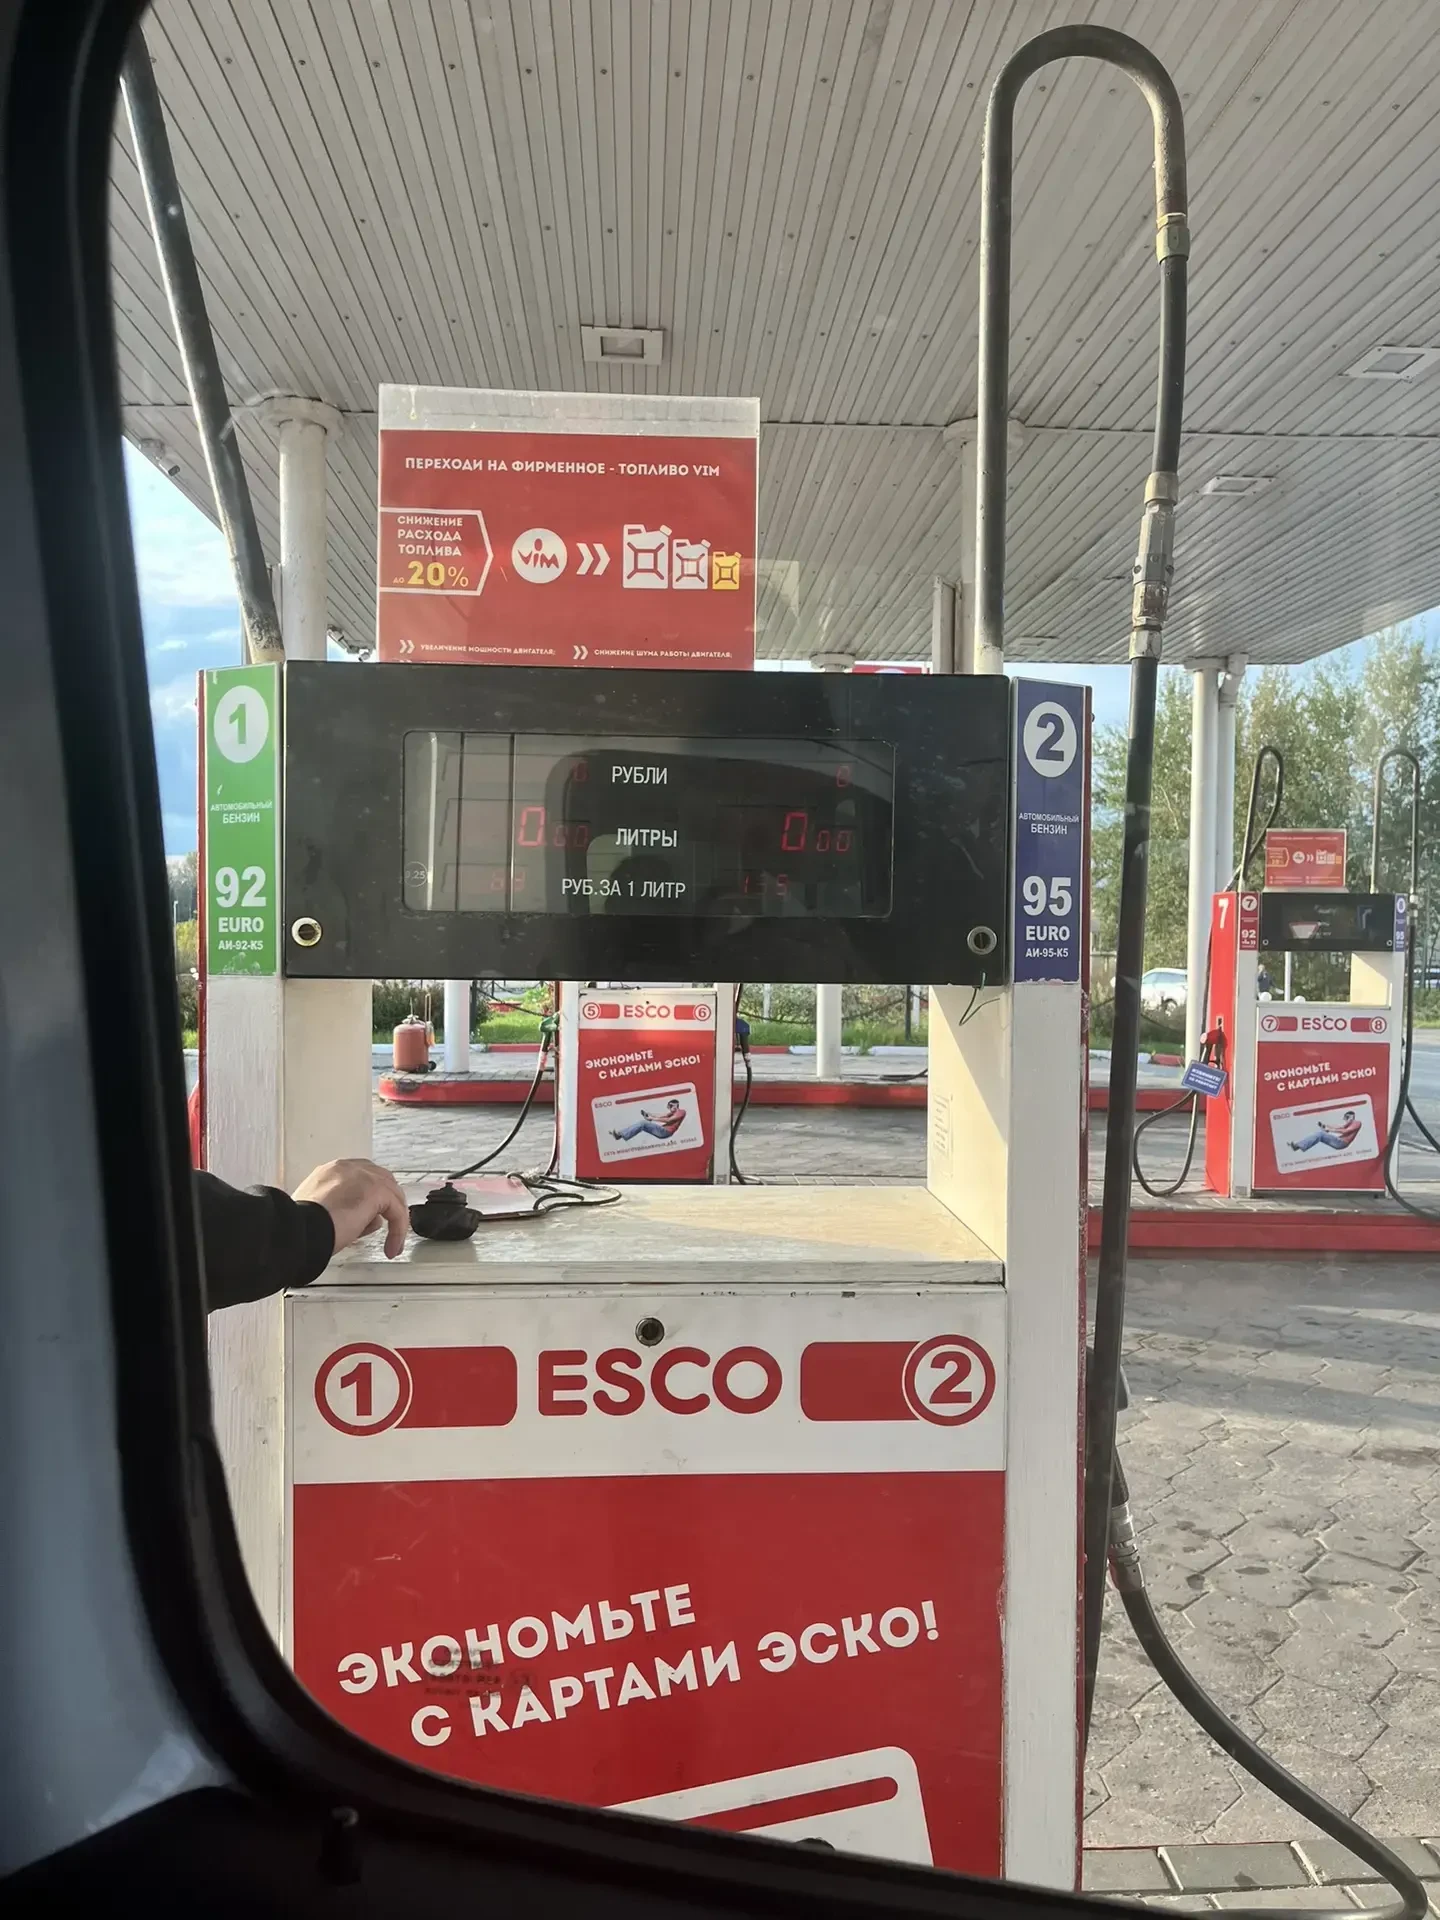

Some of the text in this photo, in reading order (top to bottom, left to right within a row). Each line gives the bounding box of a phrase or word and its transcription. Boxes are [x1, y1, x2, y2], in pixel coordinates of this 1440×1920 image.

[405, 457, 483, 471] ПЕРЕХОДИ
[487, 460, 508, 471] НА
[512, 460, 605, 473] ФИРМЕННОЕ
[618, 463, 689, 476] ТОПЛИВО
[693, 465, 720, 477] VIM
[397, 515, 463, 527] СНИЖЕНИЕ
[397, 529, 462, 542] РАСХОДА
[398, 544, 462, 556] ТОПЛИВА
[407, 560, 469, 587] 20%
[420, 644, 467, 652] УВЕЛИЧЕНИЕ
[468, 646, 512, 654] МОЩНОСТИ
[594, 649, 635, 657] СНИЖЕНИЕ
[228, 703, 247, 745] 1
[1036, 713, 1065, 762] 2
[611, 766, 668, 785] РУБЛИ
[210, 799, 273, 811] АВТОМОБИЛЬНЫЙ
[222, 812, 260, 824] БЕНЗИН
[1019, 812, 1080, 823] АВТОМОБИЛЬНЫЙ
[1030, 823, 1068, 835] БЕНЗИН
[615, 827, 678, 848] ЛИТРЫ
[215, 866, 267, 908] 92
[628, 881, 636, 898] 1
[642, 881, 686, 899] ЛИТР
[1022, 875, 1072, 917] 95
[1246, 898, 1253, 909] 7
[1218, 898, 1229, 929] 7
[218, 917, 264, 933] EURO
[1026, 926, 1070, 941] EURO
[1241, 930, 1256, 939] 92
[218, 940, 263, 951] АИ-92-К5
[1025, 948, 1069, 959] АИ-95-К5
[587, 1005, 598, 1018] 5
[623, 1005, 670, 1018] ESCO
[698, 1006, 707, 1018] 6
[1265, 1020, 1274, 1030] 7
[1301, 1017, 1347, 1031] ESCO
[1375, 1019, 1383, 1031] 8
[585, 1049, 654, 1069] ЭКОНОМЬТЕ
[599, 1054, 701, 1079] С КАРТАМИ ЭСКО!
[1264, 1062, 1331, 1081] ЭКОНОМЬТЕ
[1277, 1066, 1377, 1092] С КАРТАМИ ЭСКО!
[594, 1101, 612, 1109] ESCO
[537, 1346, 782, 1416] ESCO
[929, 1352, 973, 1404] 2
[340, 1362, 373, 1416] 1
[338, 1583, 696, 1694] ЭКОНОМЬТЕ
[411, 1705, 452, 1746] С
[469, 1641, 741, 1737] КАРТАМИ
[757, 1600, 940, 1673] ЭСКО!
